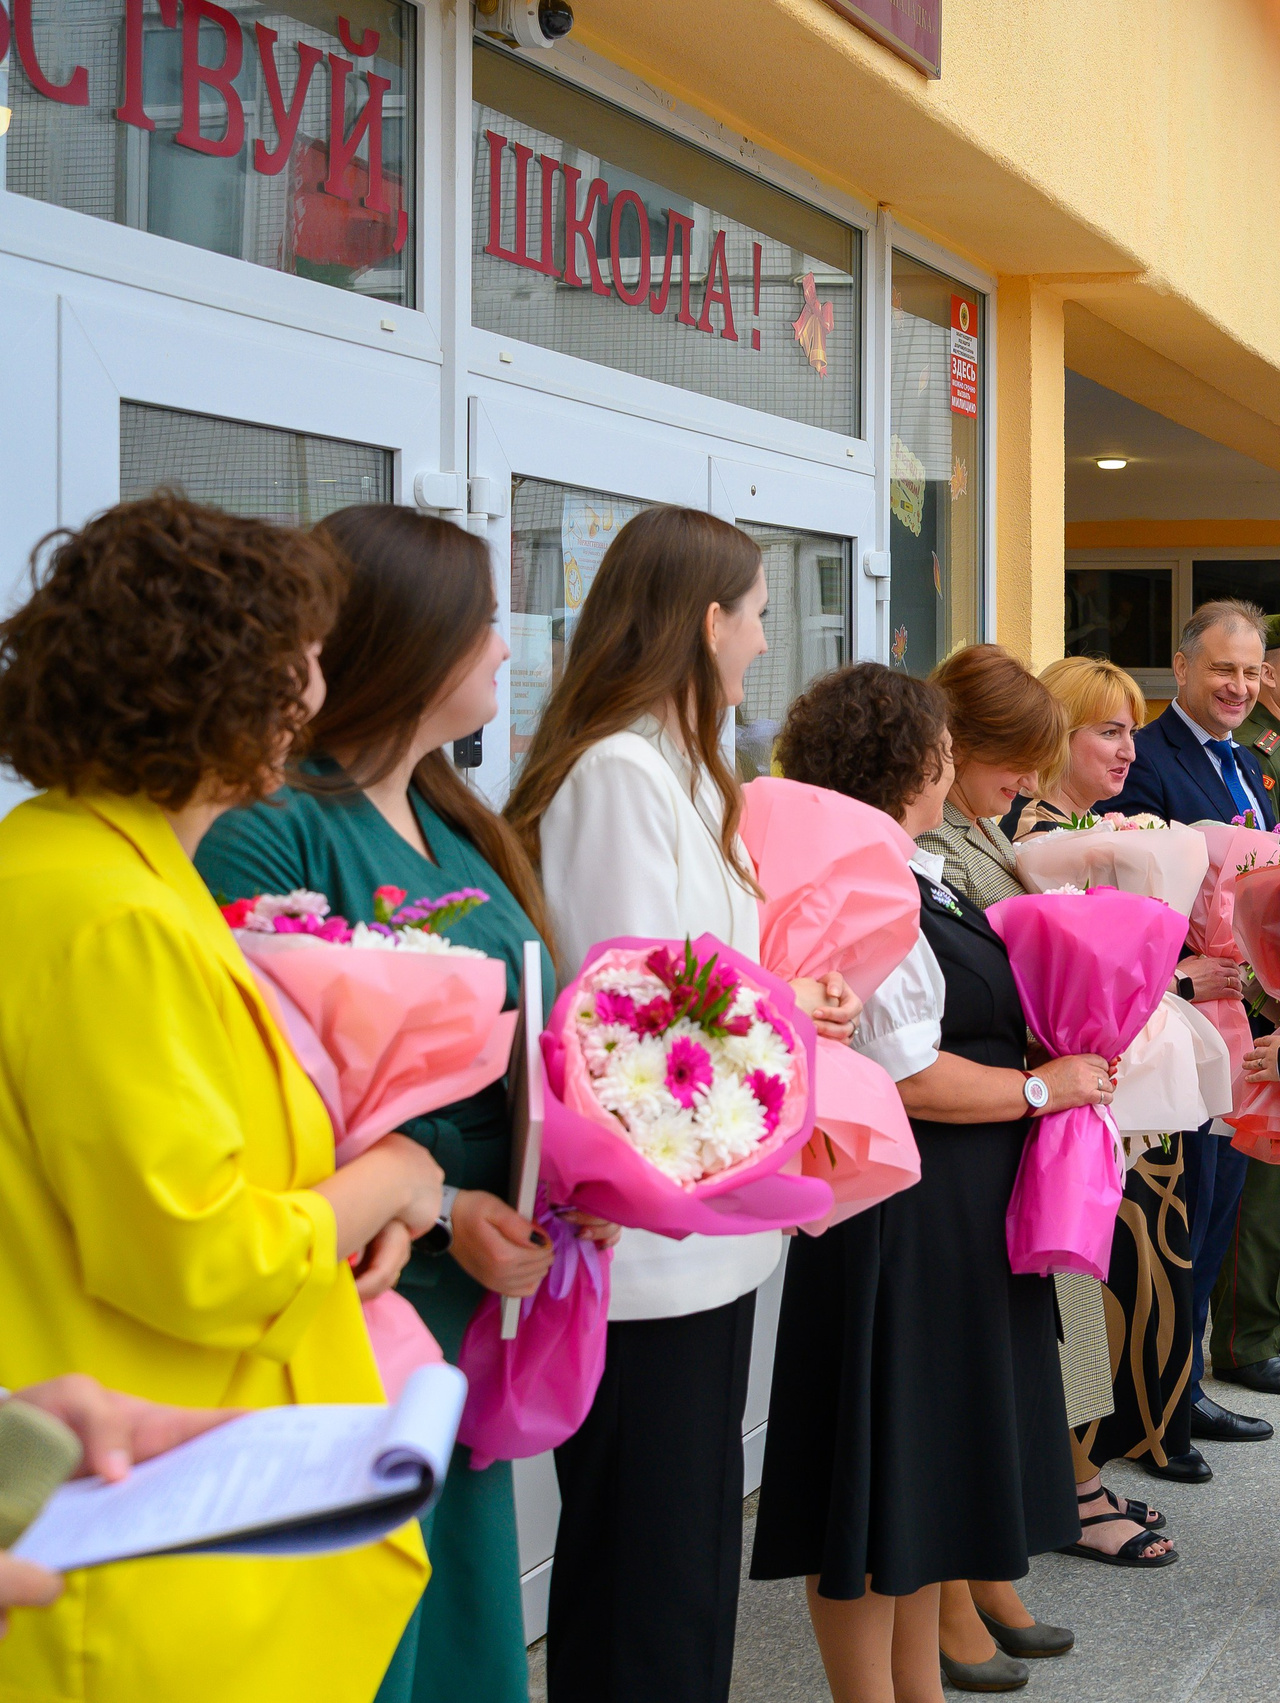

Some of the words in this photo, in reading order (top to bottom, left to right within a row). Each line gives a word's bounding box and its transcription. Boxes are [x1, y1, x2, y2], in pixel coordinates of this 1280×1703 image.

[0, 0, 408, 254] СТВУЙ,
[485, 129, 762, 352] ШКОЛА!
[952, 357, 976, 382] ЗДЕСЬ
